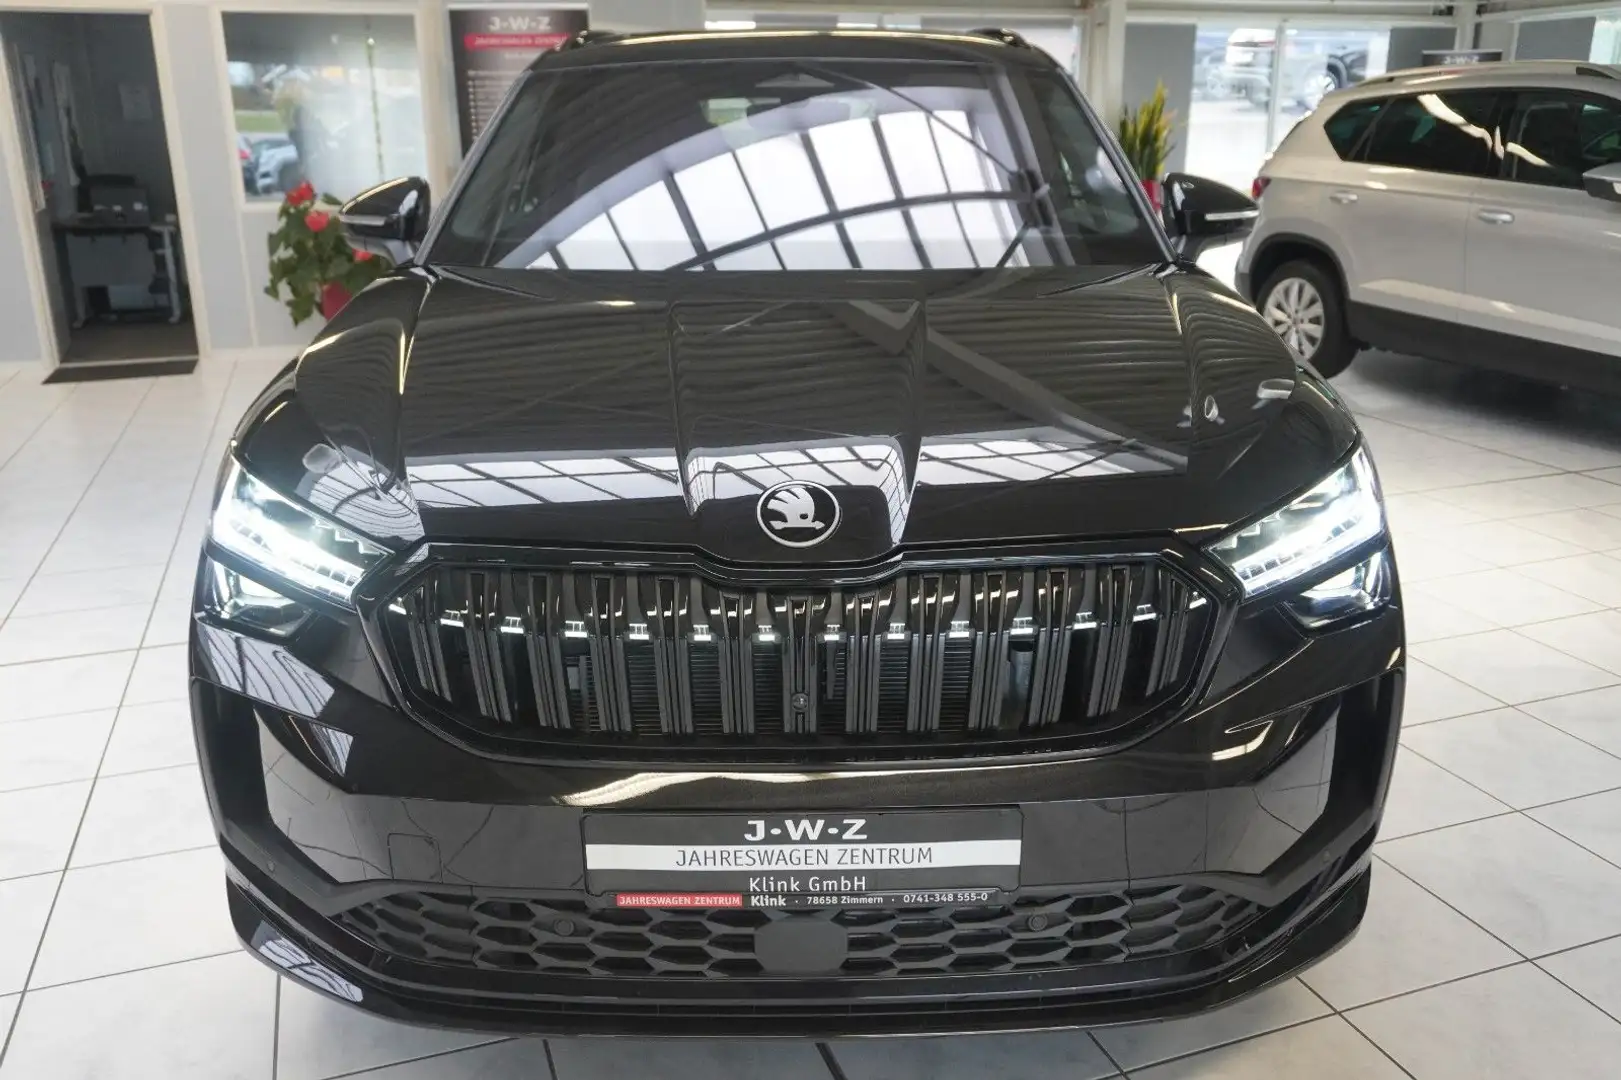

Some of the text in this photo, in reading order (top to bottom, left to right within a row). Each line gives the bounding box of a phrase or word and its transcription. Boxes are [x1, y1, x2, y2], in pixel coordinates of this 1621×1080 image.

[675, 846, 933, 867] JAHRESWAGEN ZENTRUM
[749, 875, 867, 892] Klink GmbH
[618, 892, 989, 907] JAHRESWAGEN ZENTRUM Klink 78658 Zimmern 0741-348 555-0
